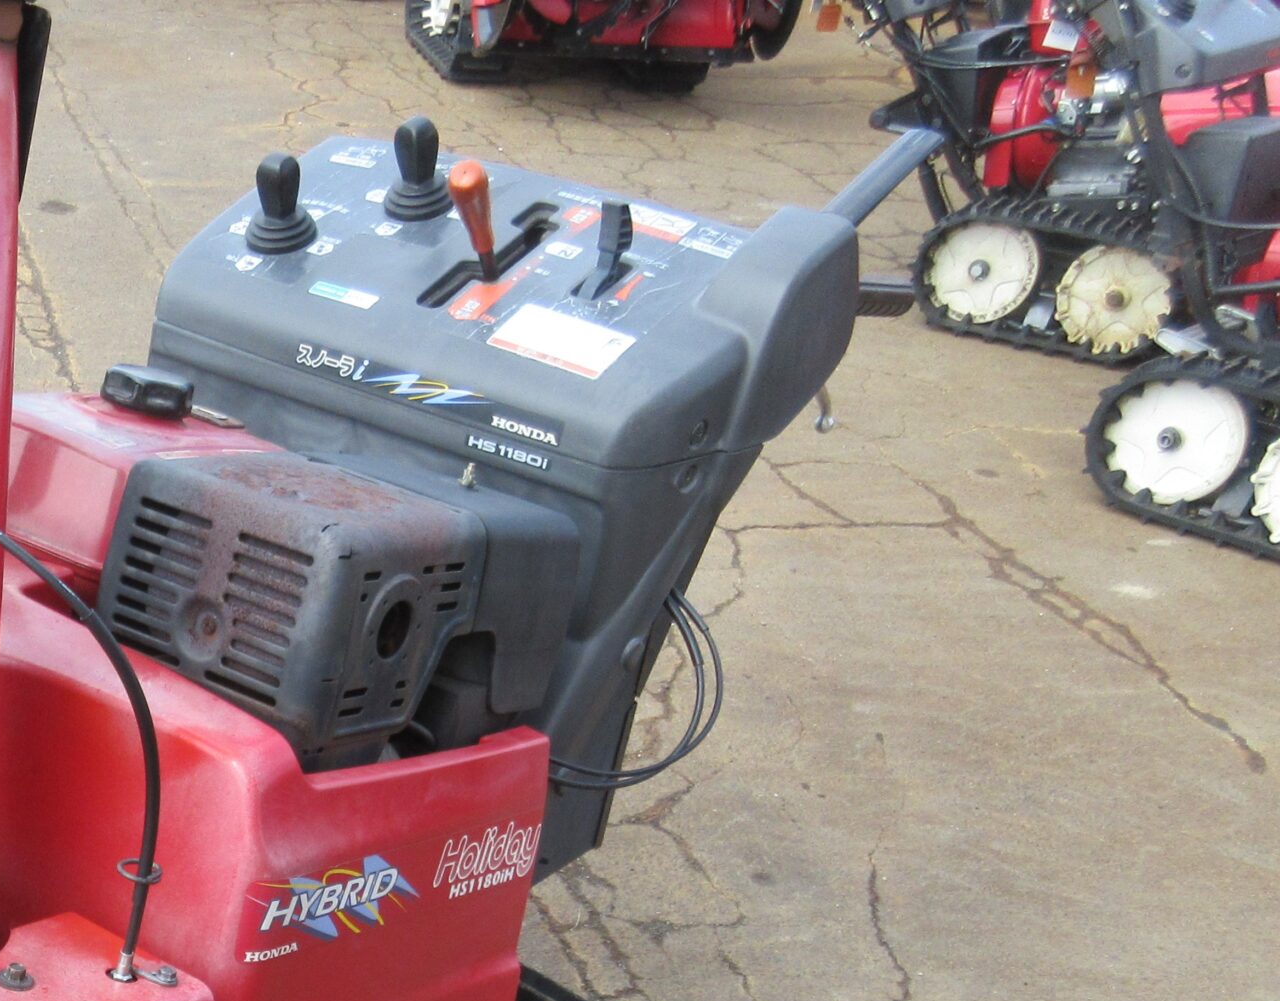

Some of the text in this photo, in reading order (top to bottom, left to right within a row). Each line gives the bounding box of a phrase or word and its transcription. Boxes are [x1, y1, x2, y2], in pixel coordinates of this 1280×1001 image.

[490, 415, 558, 446] HONDA
[432, 821, 542, 888] Holiday
[259, 867, 399, 931] HYBRID
[448, 866, 515, 900] HS1180iH
[243, 942, 298, 963] HONDA
